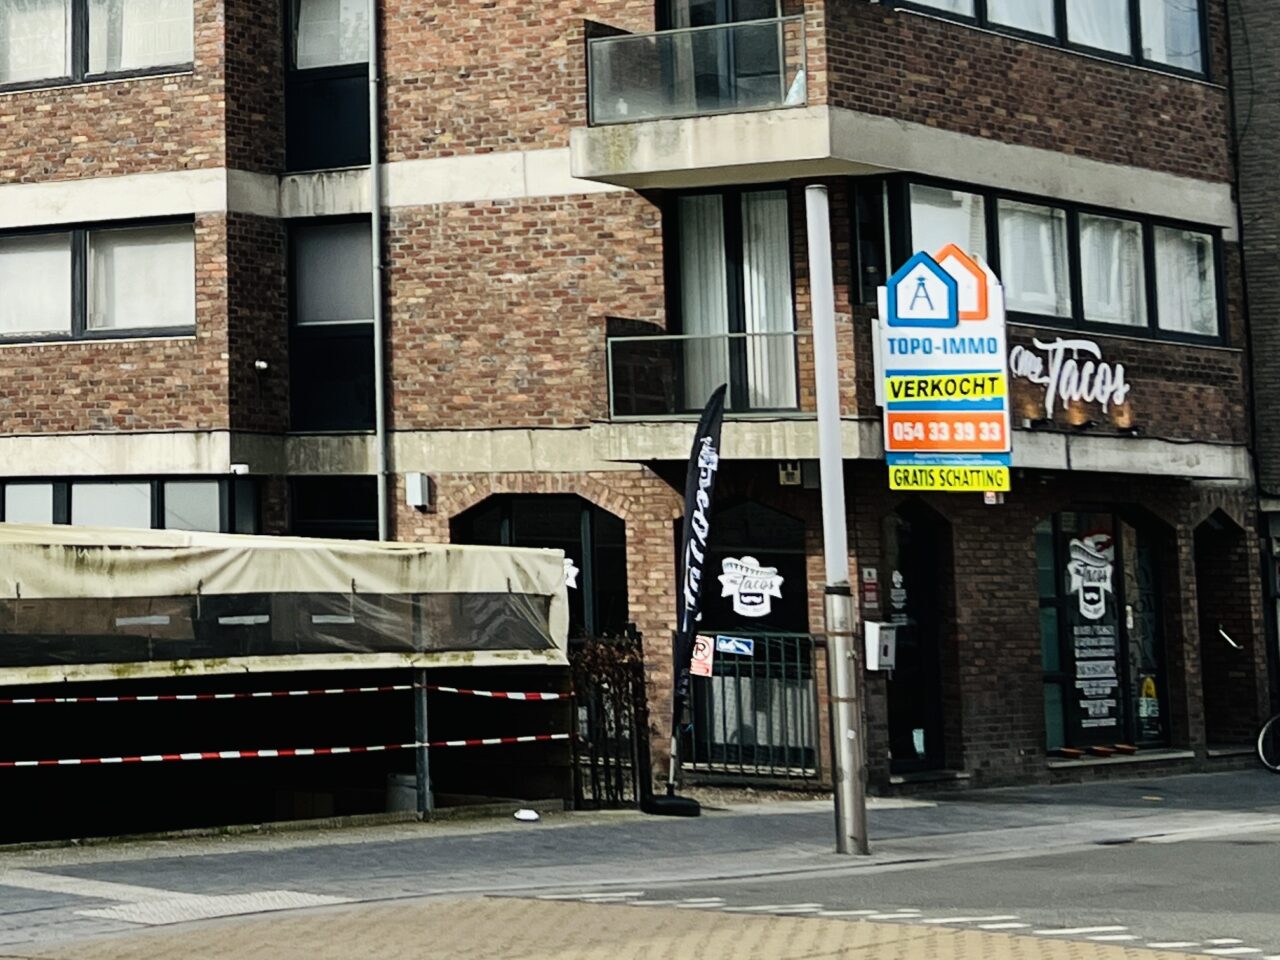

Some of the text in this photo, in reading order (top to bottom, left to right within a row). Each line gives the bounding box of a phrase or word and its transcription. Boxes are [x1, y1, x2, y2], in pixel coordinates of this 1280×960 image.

[888, 337, 998, 355] TOPO-IMMO
[890, 376, 999, 399] VERKOCHT
[1032, 337, 1130, 419] Tacos
[893, 422, 1001, 441] 054 33 39 33
[894, 468, 1004, 487] GRATIS SCHATTING
